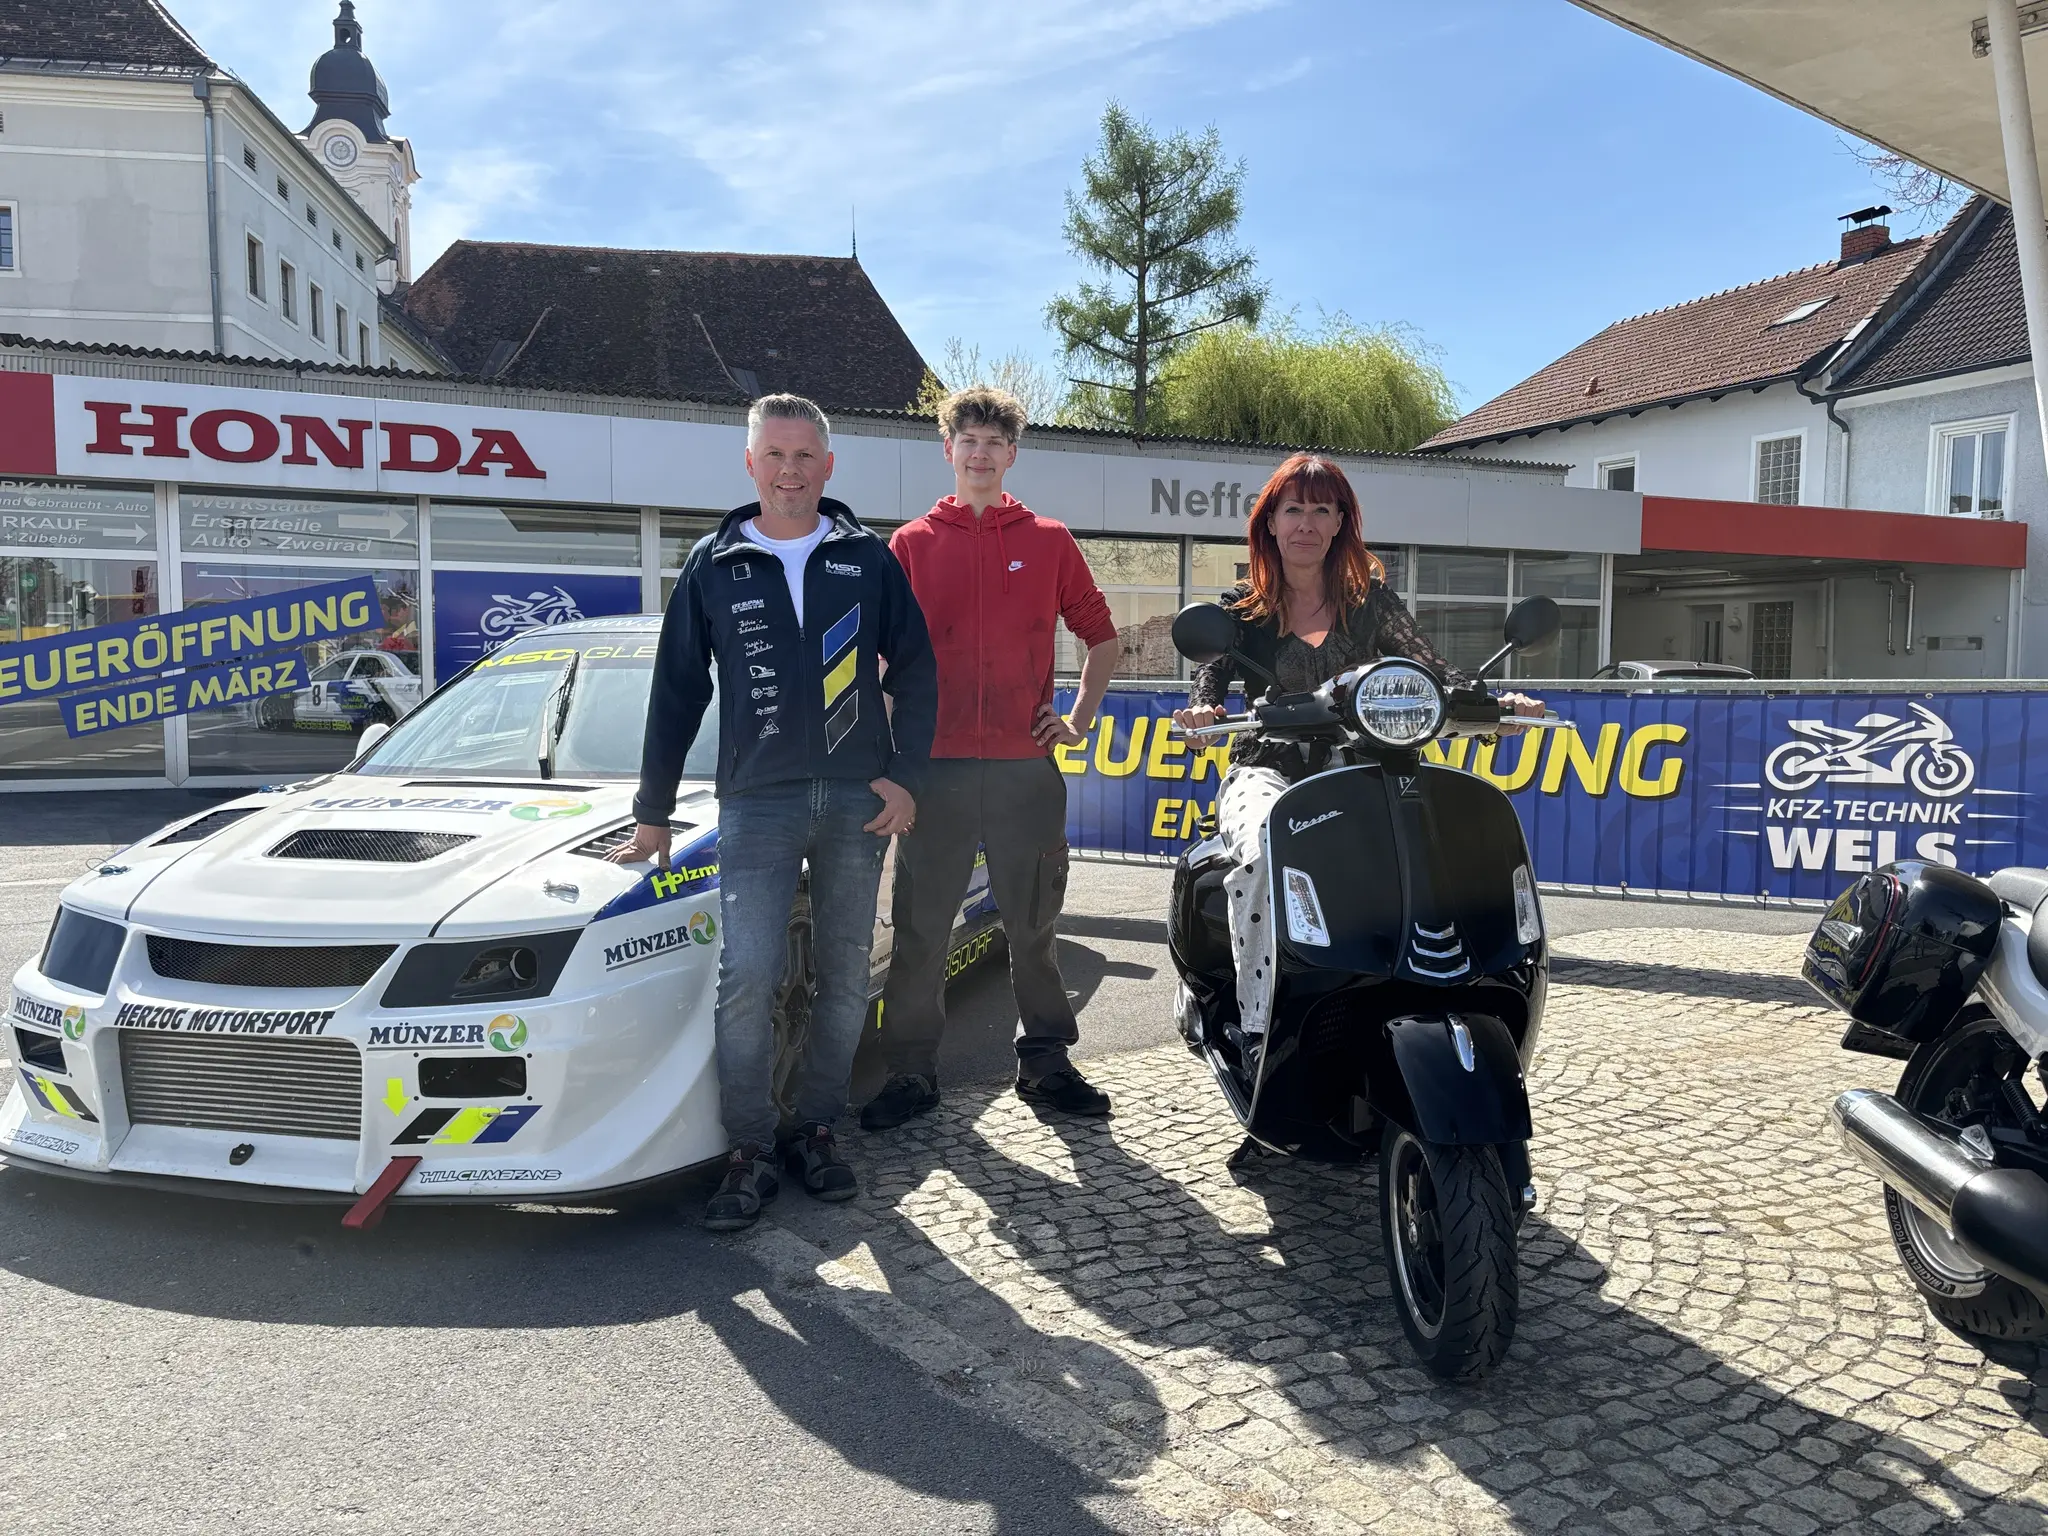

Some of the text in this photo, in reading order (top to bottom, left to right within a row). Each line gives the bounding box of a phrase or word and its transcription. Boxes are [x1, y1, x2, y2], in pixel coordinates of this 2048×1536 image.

[84, 401, 546, 479] HONDA
[0, 496, 21, 506] nd
[115, 502, 148, 512] Auto
[2, 515, 88, 530] RKAUF
[191, 514, 322, 532] Ersatzteile
[18, 532, 85, 545] Zubehör
[191, 534, 251, 548] Auto
[276, 536, 371, 552] Zweirad
[825, 559, 862, 573] MSC
[0, 591, 369, 696] EUERÖFFNUNG
[473, 647, 659, 671] MSC GLE
[75, 659, 298, 732] ENDE MÄRZ
[310, 797, 513, 811] MÜNZER
[1767, 798, 1964, 825] KFZ-TECHNIK
[1288, 810, 1343, 835] Vespa
[604, 925, 690, 966] MÜNZER
[14, 996, 62, 1027] MÜNZER
[114, 1002, 336, 1036] HERZOG MOTORSPORT
[367, 1022, 486, 1045] MÜNZER
[419, 1169, 563, 1184] HILLCLIMBFANS
[1903, 1247, 1945, 1291] MICHELIN
